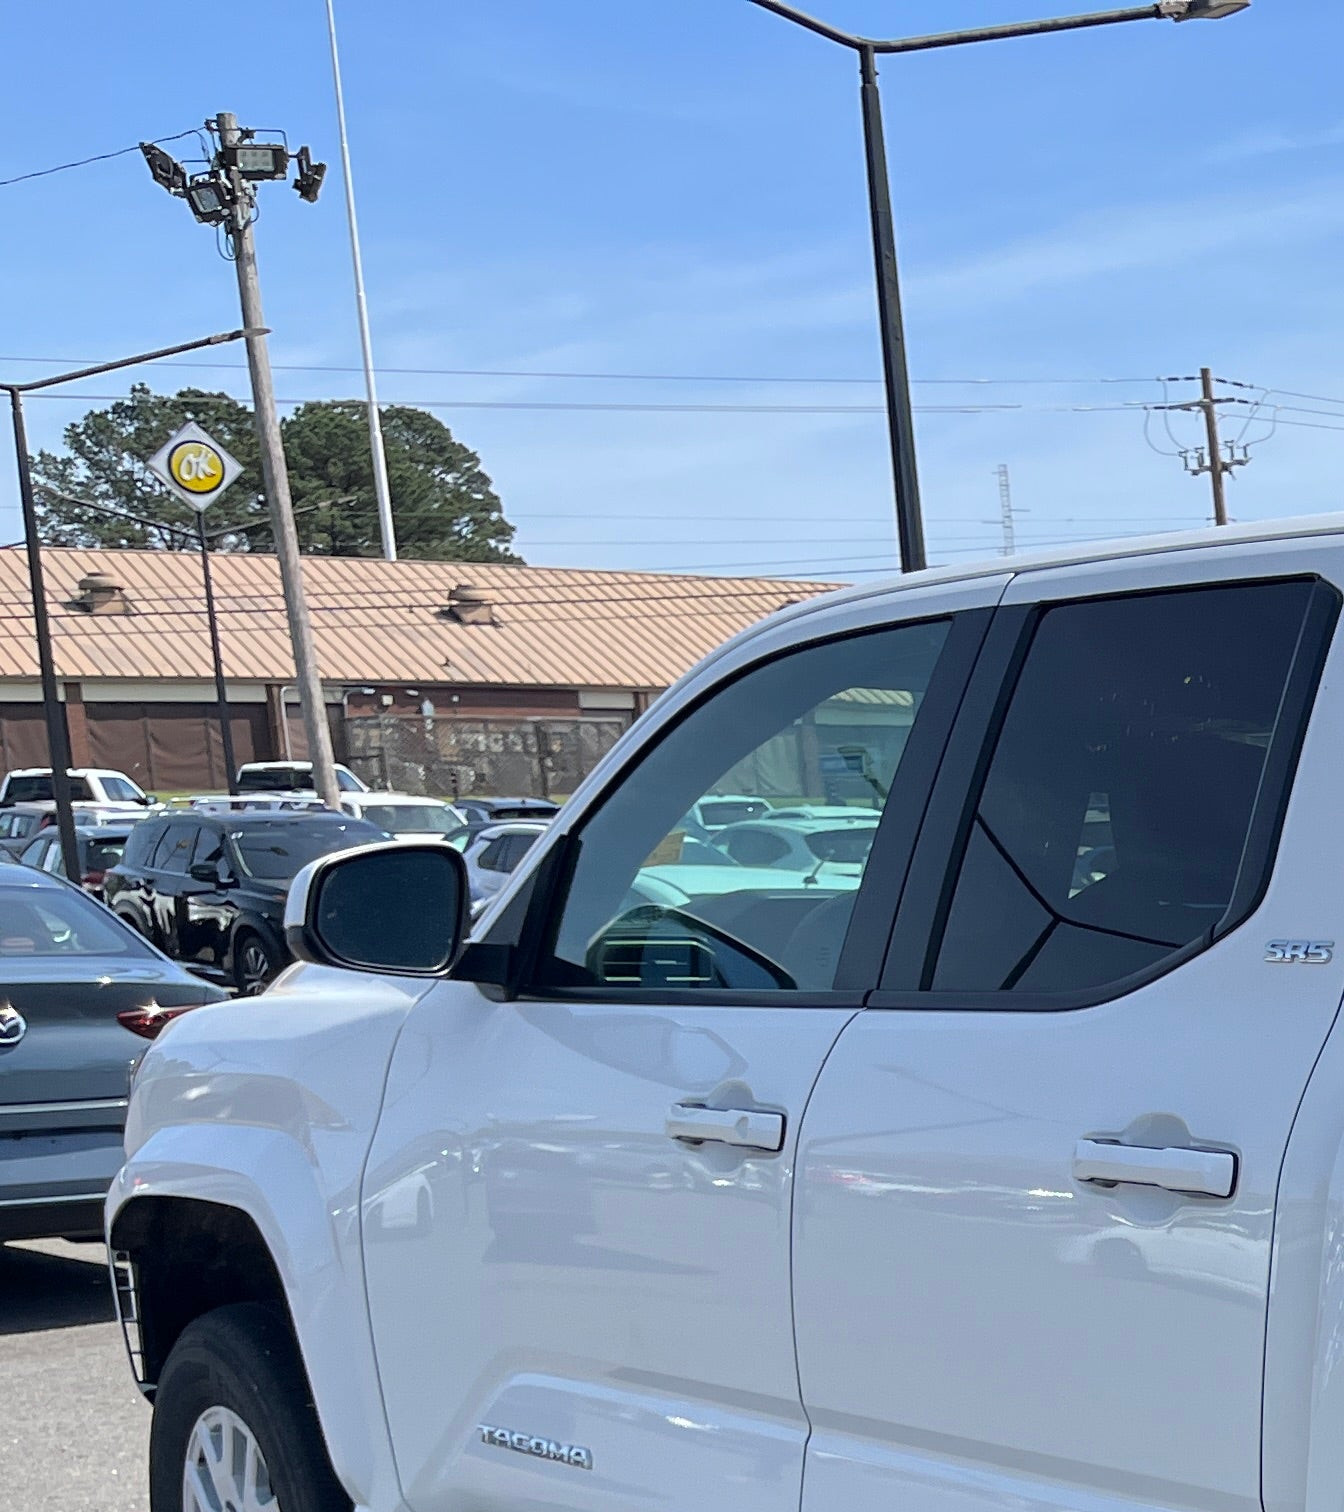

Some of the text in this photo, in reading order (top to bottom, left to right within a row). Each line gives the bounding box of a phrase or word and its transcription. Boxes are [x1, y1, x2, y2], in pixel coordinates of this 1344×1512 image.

[179, 444, 217, 482] OK
[1264, 939, 1335, 964] SR5
[477, 1424, 593, 1470] TACOMA
